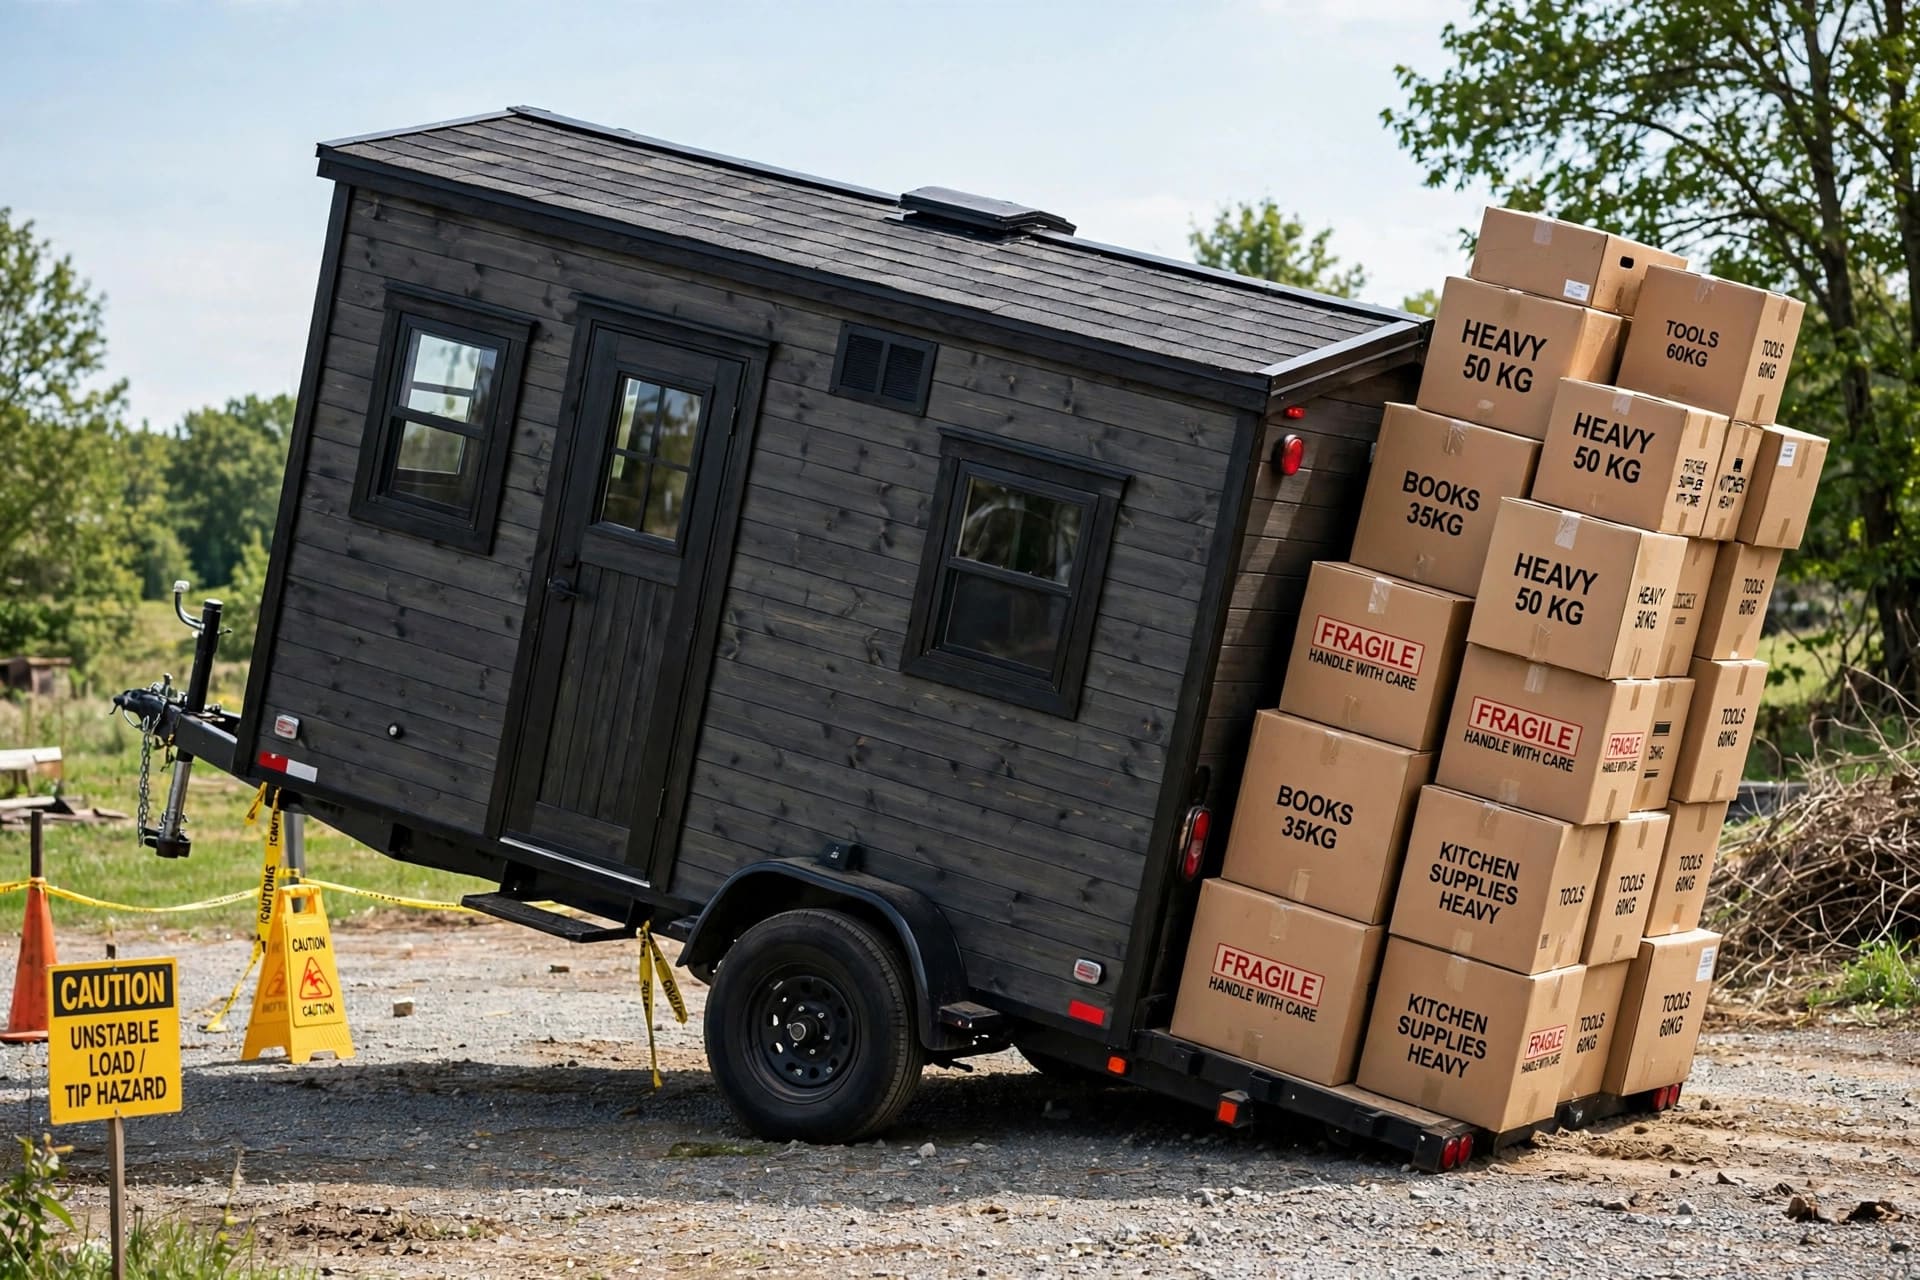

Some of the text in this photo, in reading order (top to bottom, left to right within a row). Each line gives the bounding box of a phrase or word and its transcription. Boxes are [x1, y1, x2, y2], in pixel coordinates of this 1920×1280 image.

[1462, 319, 1547, 361] HEAVY
[1666, 320, 1719, 348] TOOLS
[1762, 339, 1784, 359] TOOLS
[1667, 346, 1708, 367] 60KG
[1758, 361, 1776, 380] 60KG
[1463, 355, 1533, 393] 50 KG
[1572, 412, 1655, 454] HEAVY
[1573, 446, 1641, 484] 50 KG
[1402, 470, 1480, 512] BOOKS
[1407, 503, 1463, 536] 35KG
[1514, 553, 1598, 595] HEAVY
[1742, 578, 1765, 595] TOOLS
[1515, 587, 1584, 625] 50 KG
[1637, 586, 1667, 605] HEAVY
[1320, 623, 1417, 669] FRAGILE
[1309, 648, 1417, 691] HANDLE WITH CARE
[1475, 703, 1574, 750] FRAGILE
[1721, 708, 1746, 725] TOOLS
[1464, 730, 1575, 773] HANDLE WITH CARE
[1607, 736, 1641, 756] FRAGILE
[1276, 785, 1354, 826] BOOKS
[1282, 816, 1337, 849] 35KG
[1439, 841, 1520, 881] KITCHEN
[1679, 854, 1703, 871] TOOLS
[1429, 864, 1519, 905] SUPPLIES
[1559, 885, 1586, 906] TOOLS
[1618, 874, 1645, 893] TOOLS
[1675, 875, 1696, 892] 60KG
[1439, 891, 1501, 924] HEAVY
[1615, 897, 1636, 916] 60KG
[292, 936, 326, 953] CAUTION
[60, 971, 165, 1011] CAUTION
[1220, 950, 1317, 1000] FRAGILE
[302, 1002, 336, 1018] CAUTION
[1208, 976, 1317, 1022] HANDLE WITH CARE
[1407, 993, 1488, 1034] KITCHEN
[1662, 991, 1691, 1012] TOOLS
[70, 1019, 160, 1049] UNSTABLE
[1397, 1016, 1487, 1059] SUPPLIES
[1579, 1012, 1605, 1032] TOOLS
[1660, 1016, 1683, 1037] 60KG
[1529, 1029, 1563, 1054] FRAGILE
[1577, 1035, 1597, 1054] 60KG
[89, 1049, 146, 1078] LOAD /
[1407, 1043, 1470, 1079] HEAVY
[65, 1077, 167, 1108] TIP HAZARD
